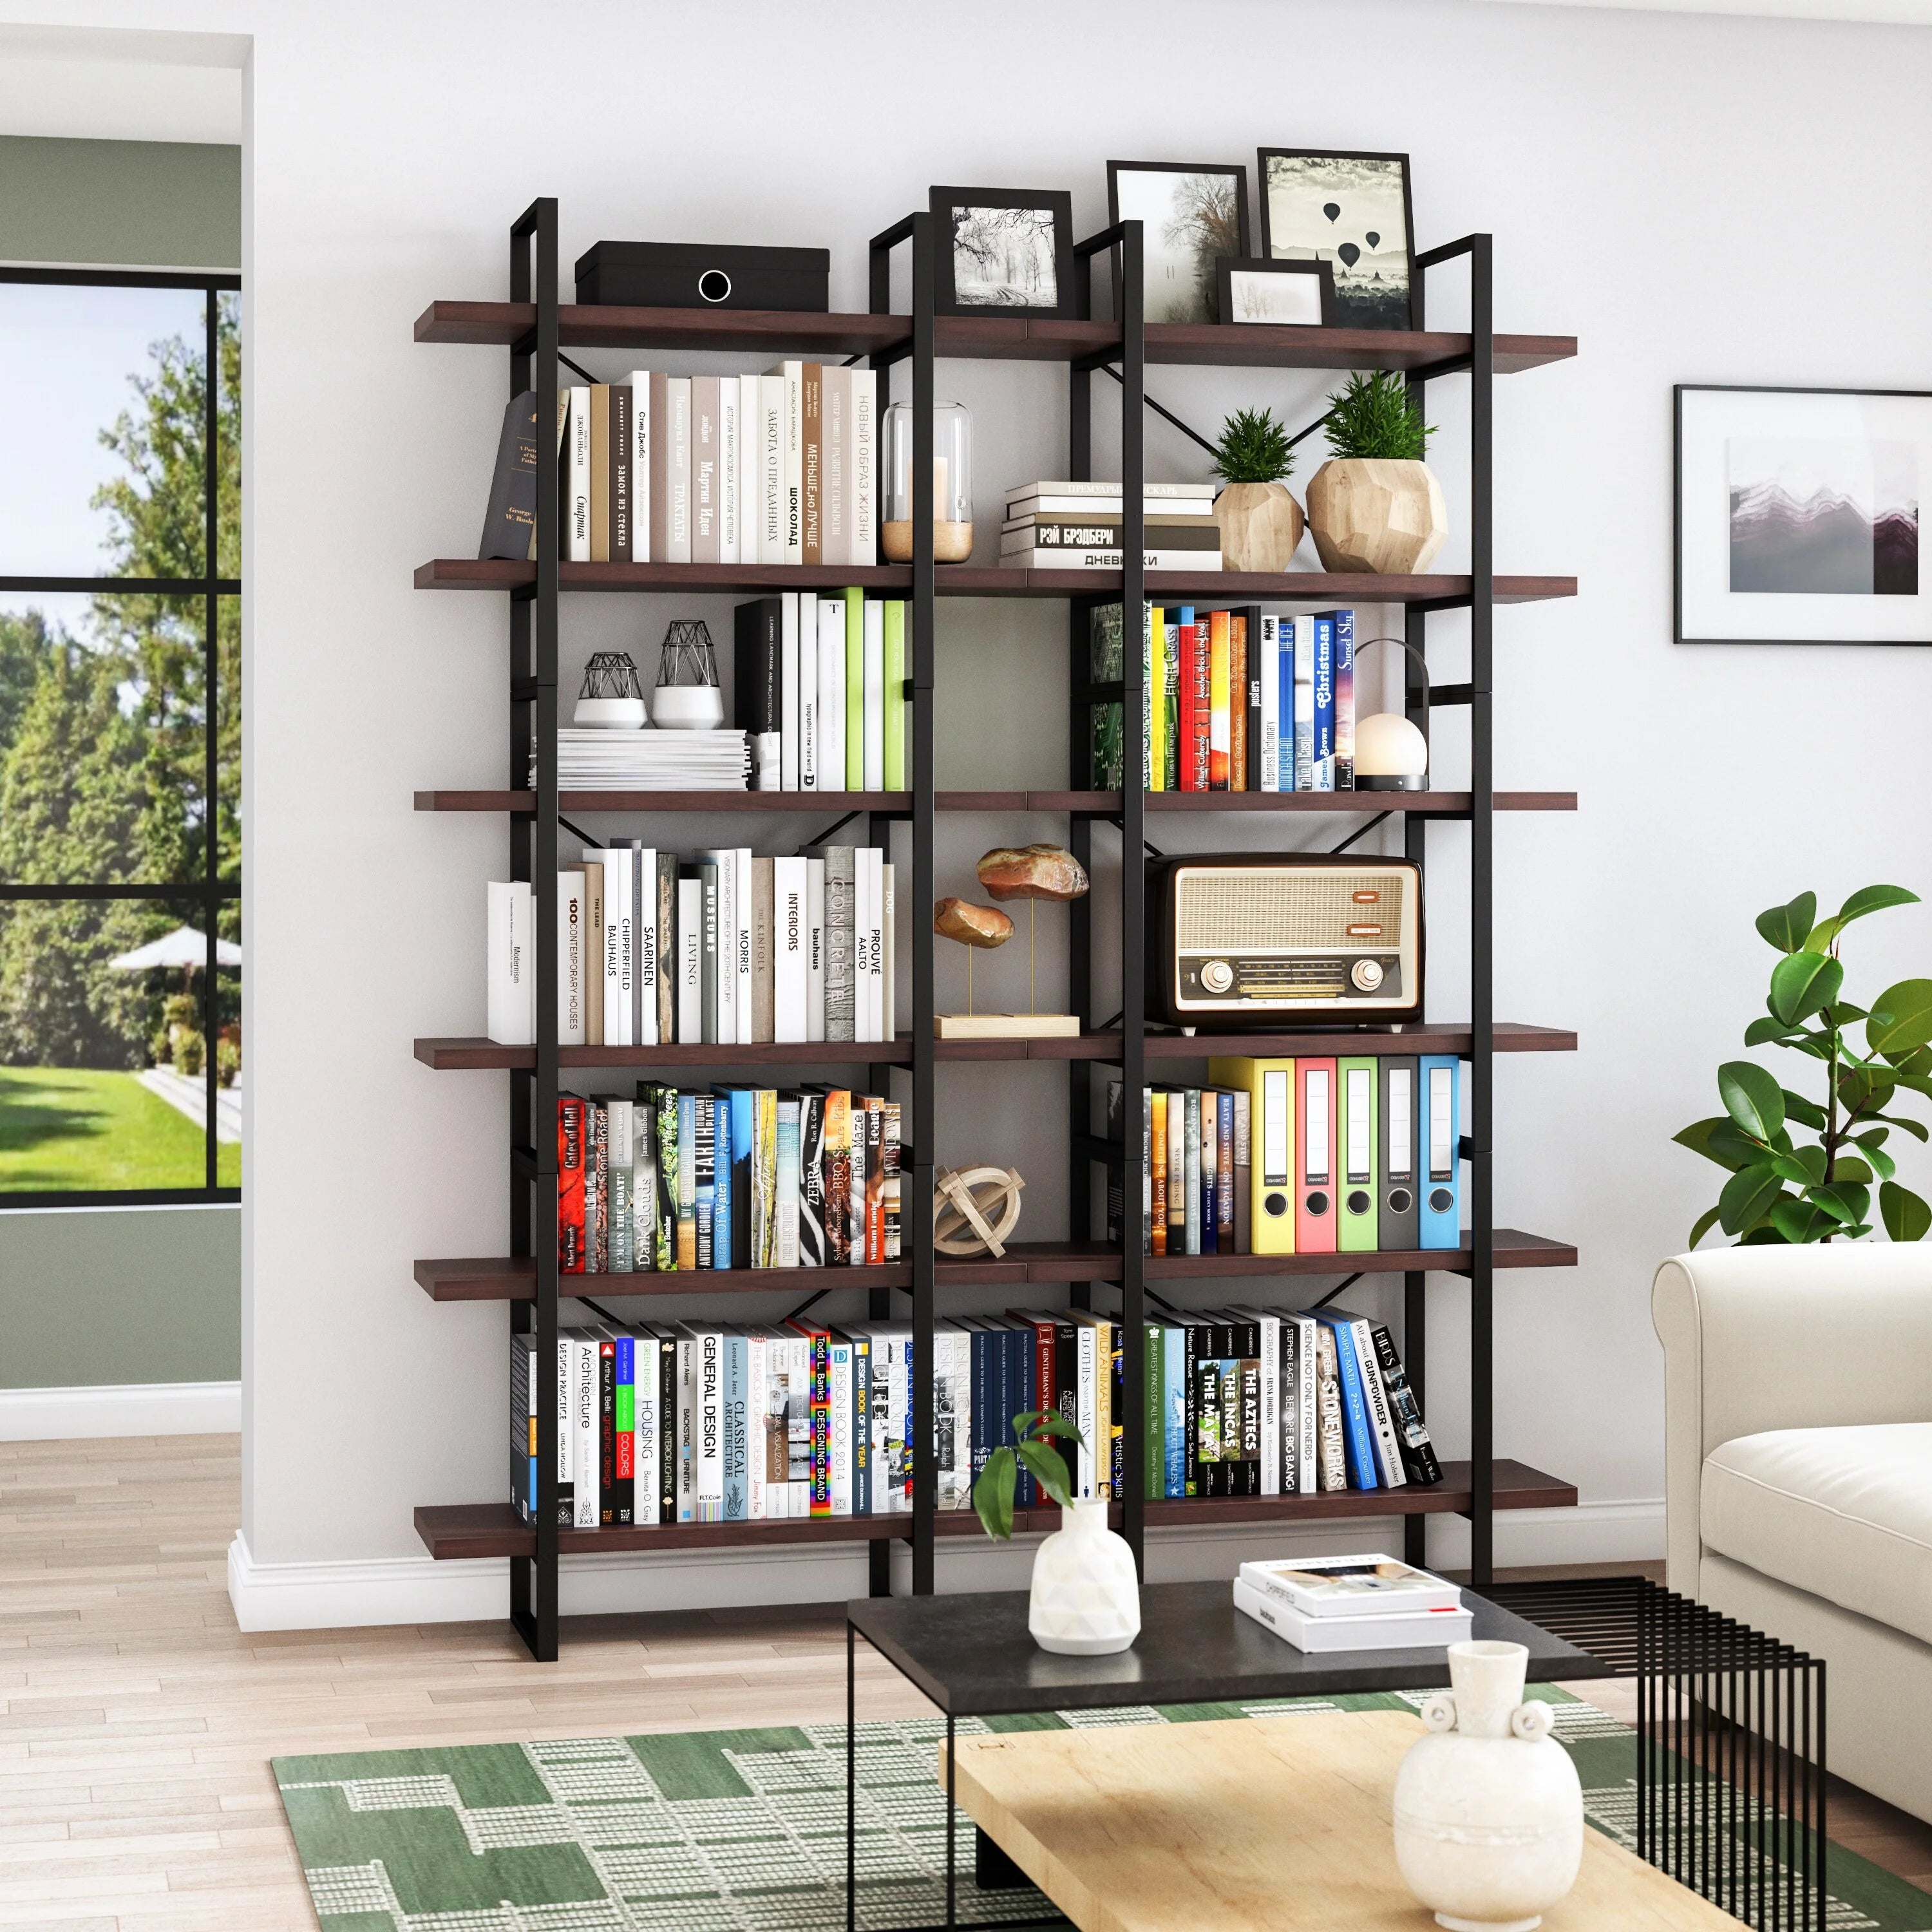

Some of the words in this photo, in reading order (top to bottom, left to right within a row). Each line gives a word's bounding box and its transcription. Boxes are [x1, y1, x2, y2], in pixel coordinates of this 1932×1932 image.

[768, 409, 777, 452] ЗАБОТА
[858, 395, 871, 443] НОВЫЙ
[768, 457, 777, 465] О
[858, 448, 869, 489] ОБРАЗ
[698, 461, 713, 503] Мартин
[574, 496, 587, 540] Спартак
[674, 483, 685, 542] ТРАКТАТЫ
[699, 508, 712, 535] Иден
[766, 469, 777, 541] ПРЕДАННЫХ
[788, 488, 798, 545] ШОКОЛАД
[858, 493, 869, 542] ЖИЗНИ
[1039, 526, 1059, 544] РЭЙ
[1063, 529, 1113, 545] БРЭДБЕРИ
[1280, 628, 1294, 638] ICE
[1338, 616, 1353, 635] Sky
[1280, 640, 1294, 652] THE
[1338, 638, 1352, 670] Sunset
[1316, 625, 1331, 709] Christmas
[1249, 681, 1261, 706] posters
[1263, 721, 1277, 753] Dictionary
[1320, 727, 1329, 757] Brown
[1263, 757, 1275, 785] Business
[1320, 760, 1329, 788] James
[706, 886, 715, 952] MUSEUMS
[886, 891, 894, 914] DOG
[788, 893, 798, 951] INTERIORS
[830, 877, 845, 1001] CONCRETE
[621, 918, 630, 990] CHIPPERFIELD
[644, 927, 654, 986] SAARINEN
[688, 934, 696, 986] LIVING
[739, 930, 749, 973] MORRIS
[871, 929, 882, 975] PROUVÉ
[565, 1108, 578, 1127] Hell
[565, 1130, 578, 1139] of
[597, 1113, 608, 1144] Road
[852, 1115, 863, 1148] Maze
[869, 1103, 880, 1146] Beagle
[565, 1142, 578, 1168] Gates
[597, 1147, 608, 1182] Stone
[852, 1157, 863, 1181] The
[808, 1160, 820, 1206] ZEBRA
[1223, 1171, 1230, 1183] ON
[638, 1178, 651, 1226] Clouds
[699, 1204, 710, 1233] GORDIEN
[638, 1231, 651, 1265] Dark
[699, 1235, 710, 1266] ANTHONY
[817, 1336, 826, 1358] Todd
[1303, 1324, 1312, 1358] SCIENCE
[1339, 1327, 1351, 1358] SIMPLE
[704, 1336, 716, 1402] GENERAL
[817, 1361, 826, 1370] L.
[1245, 1368, 1256, 1395] THE
[1303, 1359, 1312, 1381] NOT
[1343, 1359, 1356, 1386] MATH
[582, 1347, 592, 1428] Architecture
[817, 1373, 826, 1401] Banks
[835, 1367, 846, 1408] DESIGN
[1151, 1395, 1157, 1404] OF
[1204, 1374, 1215, 1399] THE
[1224, 1373, 1236, 1399] THE
[1303, 1383, 1312, 1408] ONLY
[1364, 1360, 1388, 1426] GUNPOWDER
[641, 1401, 653, 1459] HOUSING
[704, 1406, 716, 1458] DESIGN
[835, 1413, 846, 1448] BOOK
[858, 1415, 865, 1426] OF
[1204, 1404, 1215, 1448] MAYA
[1224, 1403, 1236, 1448] INCAS
[1245, 1398, 1256, 1451] AZTECS
[1285, 1396, 1294, 1434] BEFORE
[1303, 1412, 1312, 1430] FOR
[602, 1415, 612, 1453] graphic
[734, 1401, 744, 1478] CLASSICAL
[817, 1410, 825, 1464] DESIGNING
[1285, 1436, 1294, 1454] BIG
[1303, 1432, 1312, 1461] NERDS
[1321, 1381, 1345, 1487] STONEWORKS
[1384, 1444, 1394, 1455] Jim
[620, 1434, 629, 1475] COLORS
[835, 1452, 846, 1481] 2014
[1387, 1457, 1400, 1483] Holster
[603, 1455, 612, 1489] design
[817, 1468, 825, 1500] BRAND
[1285, 1455, 1294, 1490] BANG!
